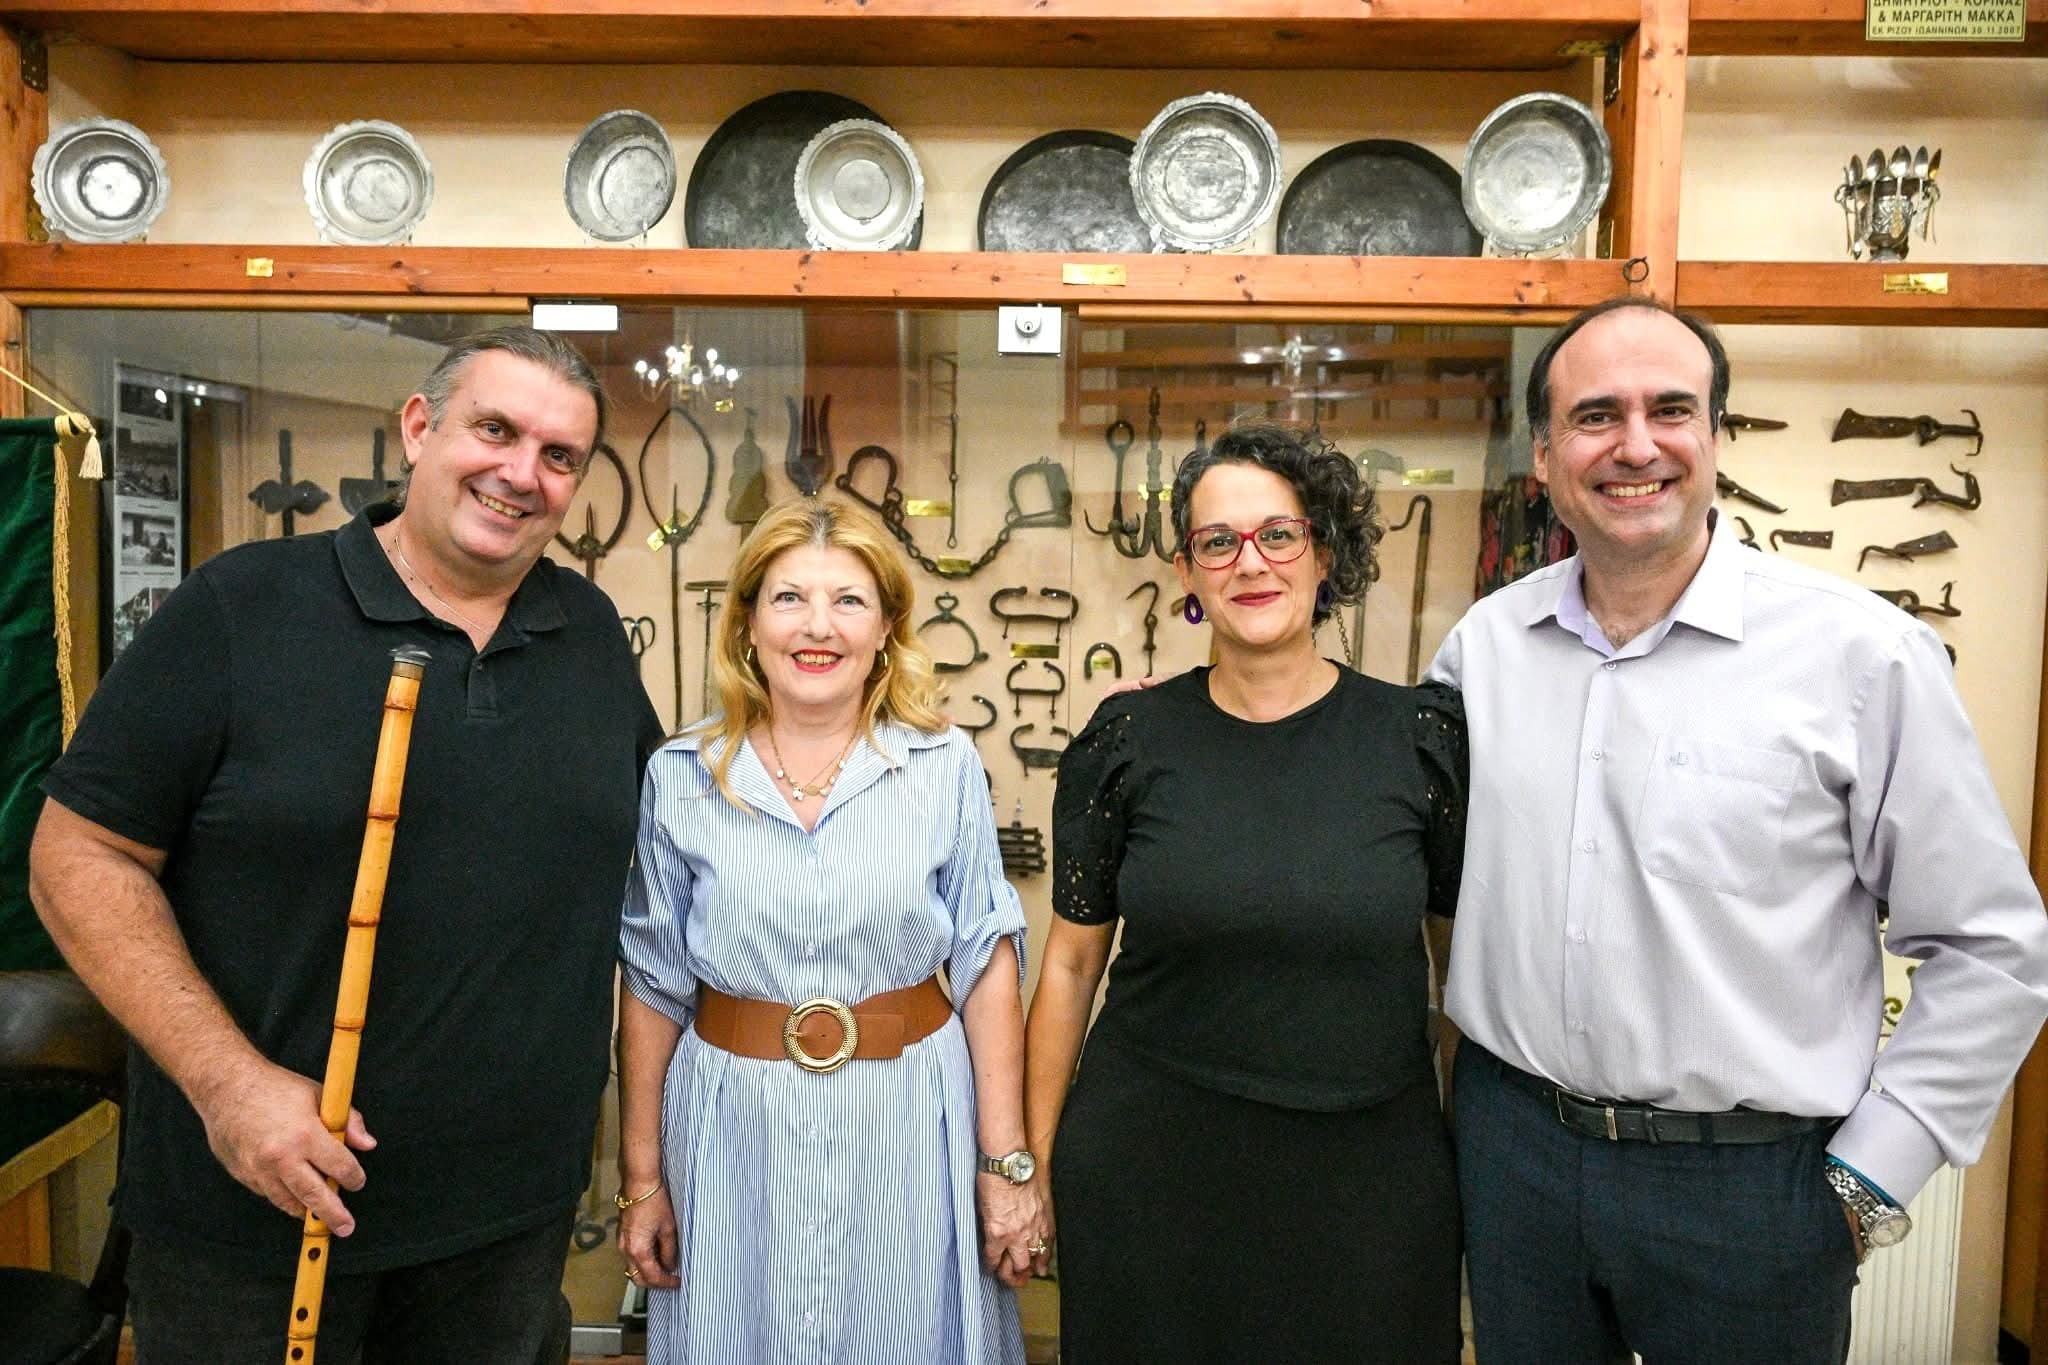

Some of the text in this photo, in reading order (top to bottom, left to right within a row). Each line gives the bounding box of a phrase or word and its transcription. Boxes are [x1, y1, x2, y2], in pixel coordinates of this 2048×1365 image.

[1878, 10, 2015, 22] & ΜΑΡΓΑΡΙΤΗ ΜΑΚΚΑ
